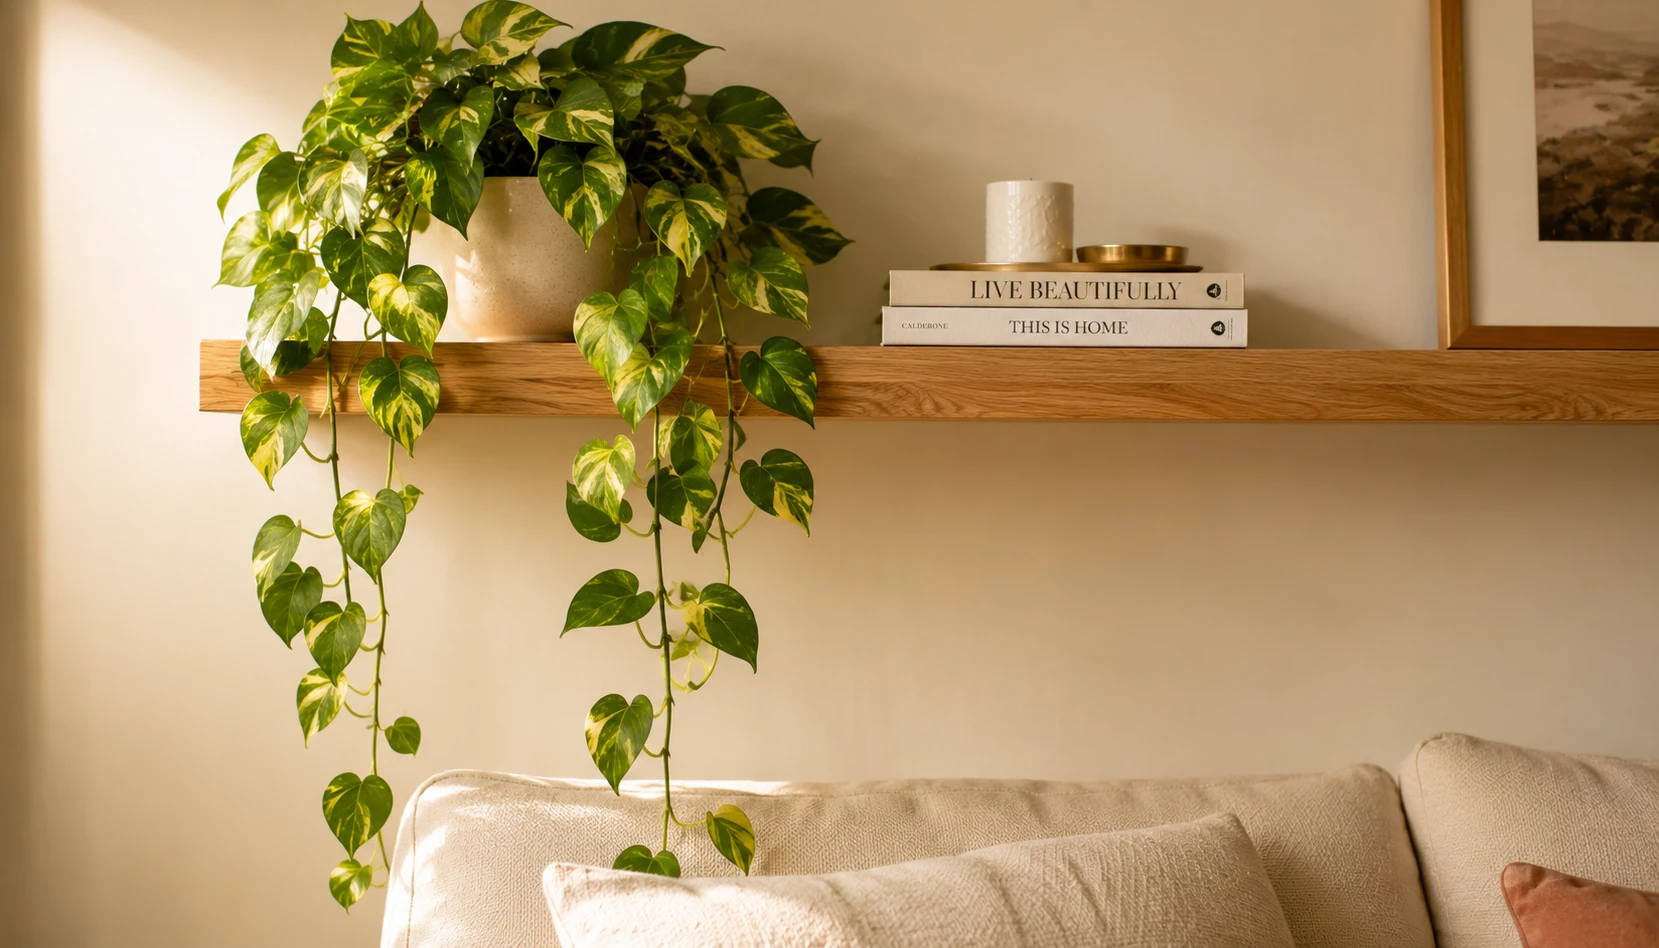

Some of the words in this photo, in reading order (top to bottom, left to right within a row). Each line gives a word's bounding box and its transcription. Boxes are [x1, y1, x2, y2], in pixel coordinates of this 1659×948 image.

[970, 280, 1023, 300] LIVE
[1030, 280, 1182, 301] BEAUTIFULLY
[901, 322, 949, 330] CALDERONE
[1008, 320, 1051, 334] THIS
[1054, 320, 1070, 334] IS
[1074, 320, 1129, 335] HOME
